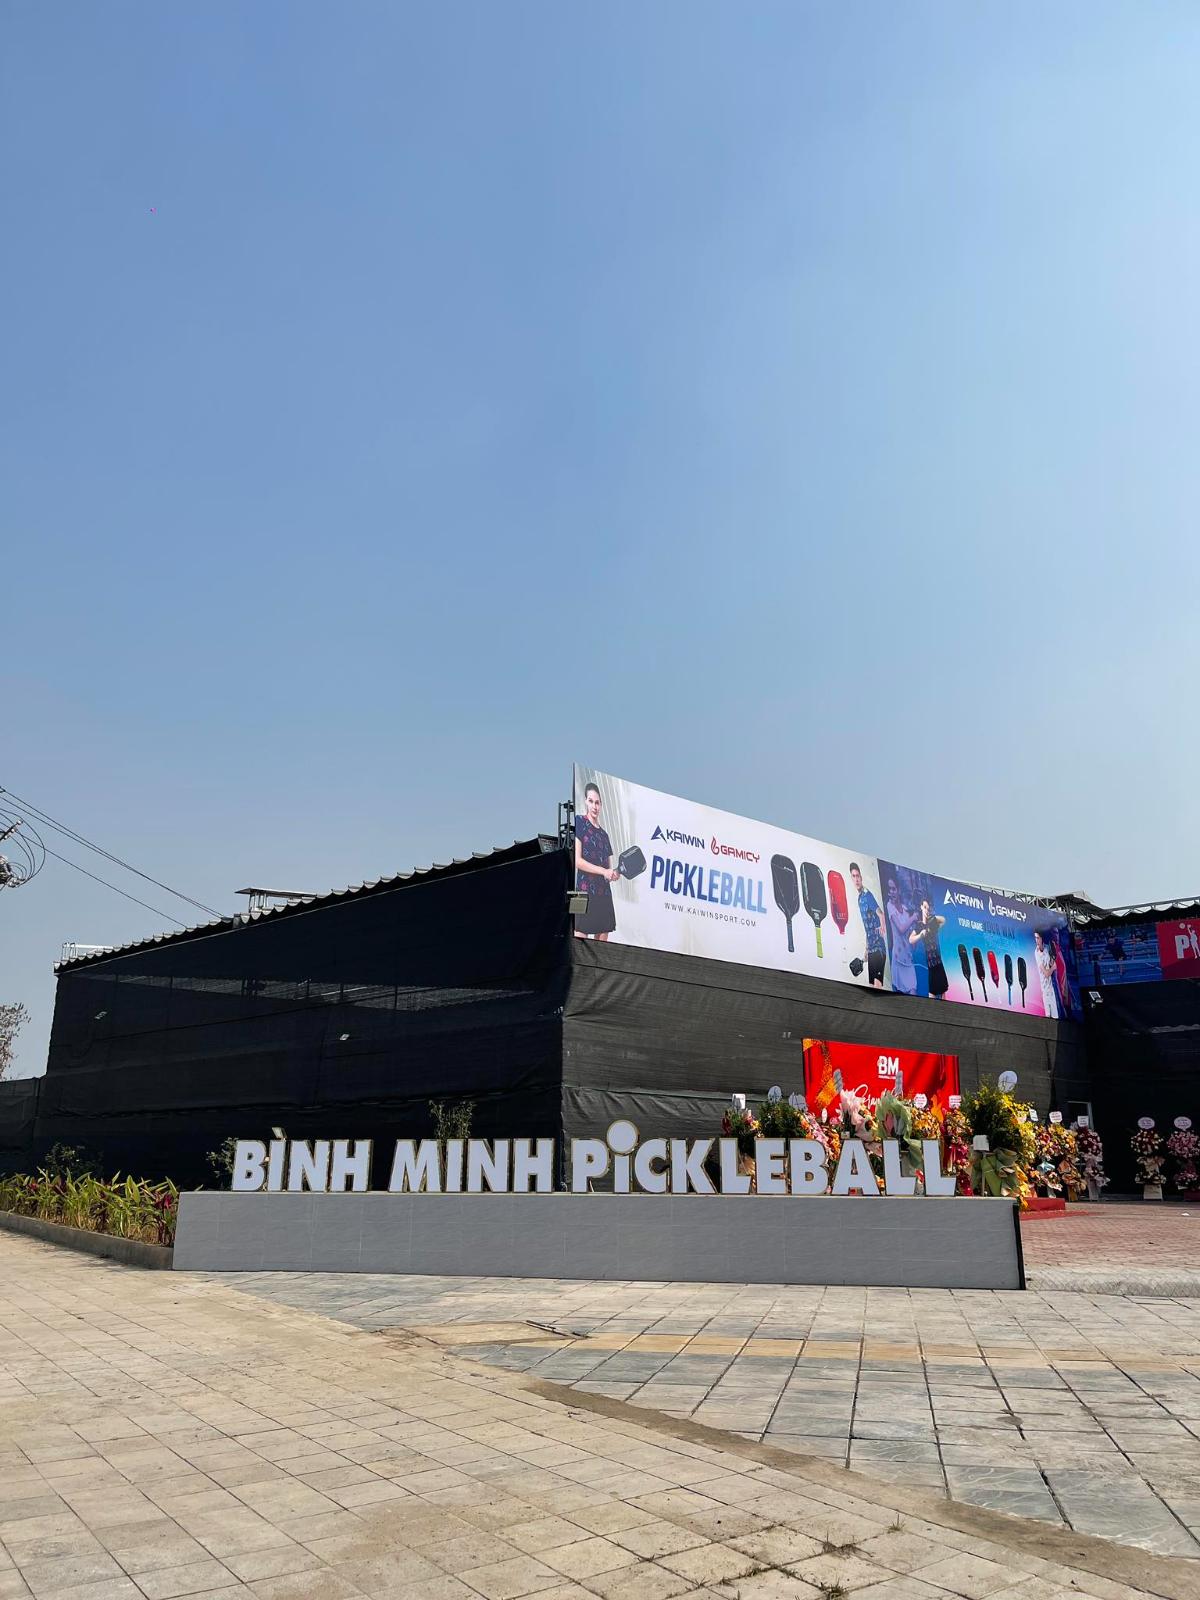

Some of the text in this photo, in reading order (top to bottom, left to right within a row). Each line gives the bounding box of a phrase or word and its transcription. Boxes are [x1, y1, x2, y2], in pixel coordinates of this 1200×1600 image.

[666, 829, 705, 849] KAIWIN
[720, 845, 760, 863] GAMICY
[650, 855, 767, 914] PICKLEBALL
[664, 902, 756, 927] WWW.KAIWINSPORT.COM
[996, 905, 1027, 922] GAMICY
[877, 1055, 899, 1075] BM
[388, 1138, 555, 1192] MINH
